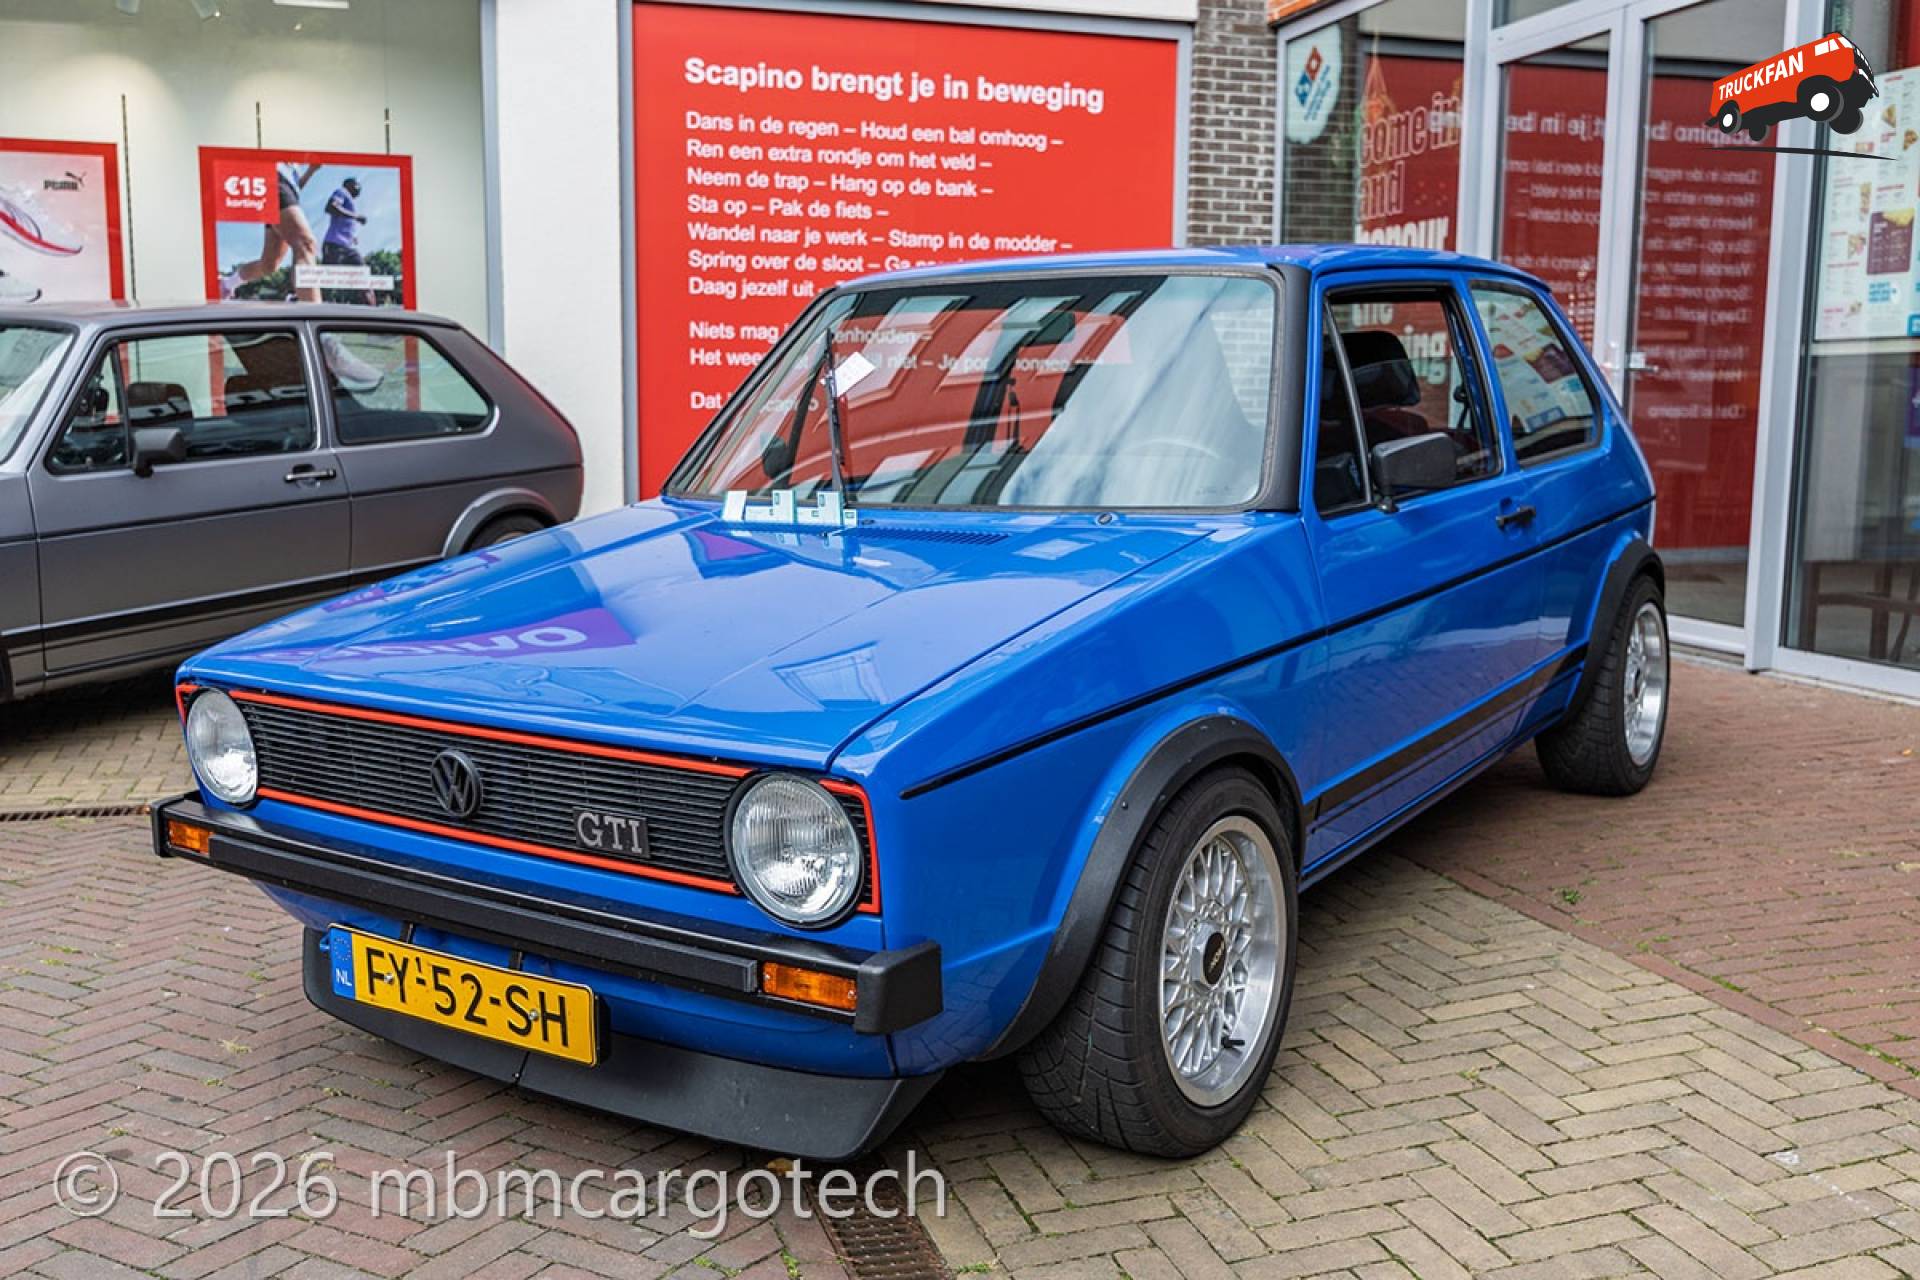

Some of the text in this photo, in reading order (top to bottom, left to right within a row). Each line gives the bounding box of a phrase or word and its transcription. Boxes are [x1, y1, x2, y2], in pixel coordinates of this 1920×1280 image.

[685, 59, 1104, 113] Scapino brengt je in beweging
[686, 111, 733, 131] Dans
[739, 114, 755, 132] in
[760, 116, 784, 134] de
[788, 121, 839, 139] regen
[861, 121, 907, 141] Houd
[912, 128, 944, 142] een
[949, 127, 975, 144] bal
[979, 130, 1047, 152] omhoog
[687, 139, 723, 158] Ren
[728, 145, 763, 160] een
[768, 146, 813, 162] extra
[817, 148, 872, 168] rondje
[876, 152, 904, 167] om
[909, 151, 936, 168] het
[941, 154, 976, 171] veld
[224, 175, 267, 197] €15
[687, 167, 741, 186] Neem
[746, 171, 769, 188] de
[774, 172, 809, 193] trap
[831, 174, 877, 197] Hang
[882, 180, 904, 197] op
[909, 178, 931, 195] de
[936, 179, 976, 197] bank
[688, 194, 718, 213] Sta
[723, 200, 747, 218] op
[769, 198, 803, 216] Pak
[808, 200, 831, 218] de
[835, 200, 872, 219] fiets
[688, 222, 755, 241] Wandel
[760, 229, 800, 243] naar
[804, 227, 821, 248] je
[826, 229, 867, 245] werk
[888, 229, 944, 251] Stamp
[949, 232, 963, 248] in
[968, 233, 990, 250] de
[995, 235, 1056, 251] modder
[688, 249, 746, 272] Spring
[752, 255, 790, 270] over
[794, 254, 817, 270] de
[822, 255, 864, 270] sloot
[689, 277, 813, 299] Daag jezelf uit
[690, 321, 735, 339] Niets
[741, 326, 779, 344] mag
[690, 348, 761, 367] Het wee
[691, 392, 723, 412] Dat
[577, 812, 642, 854] GTI
[335, 967, 353, 987] NL
[365, 946, 569, 1048] FY-52-SH
